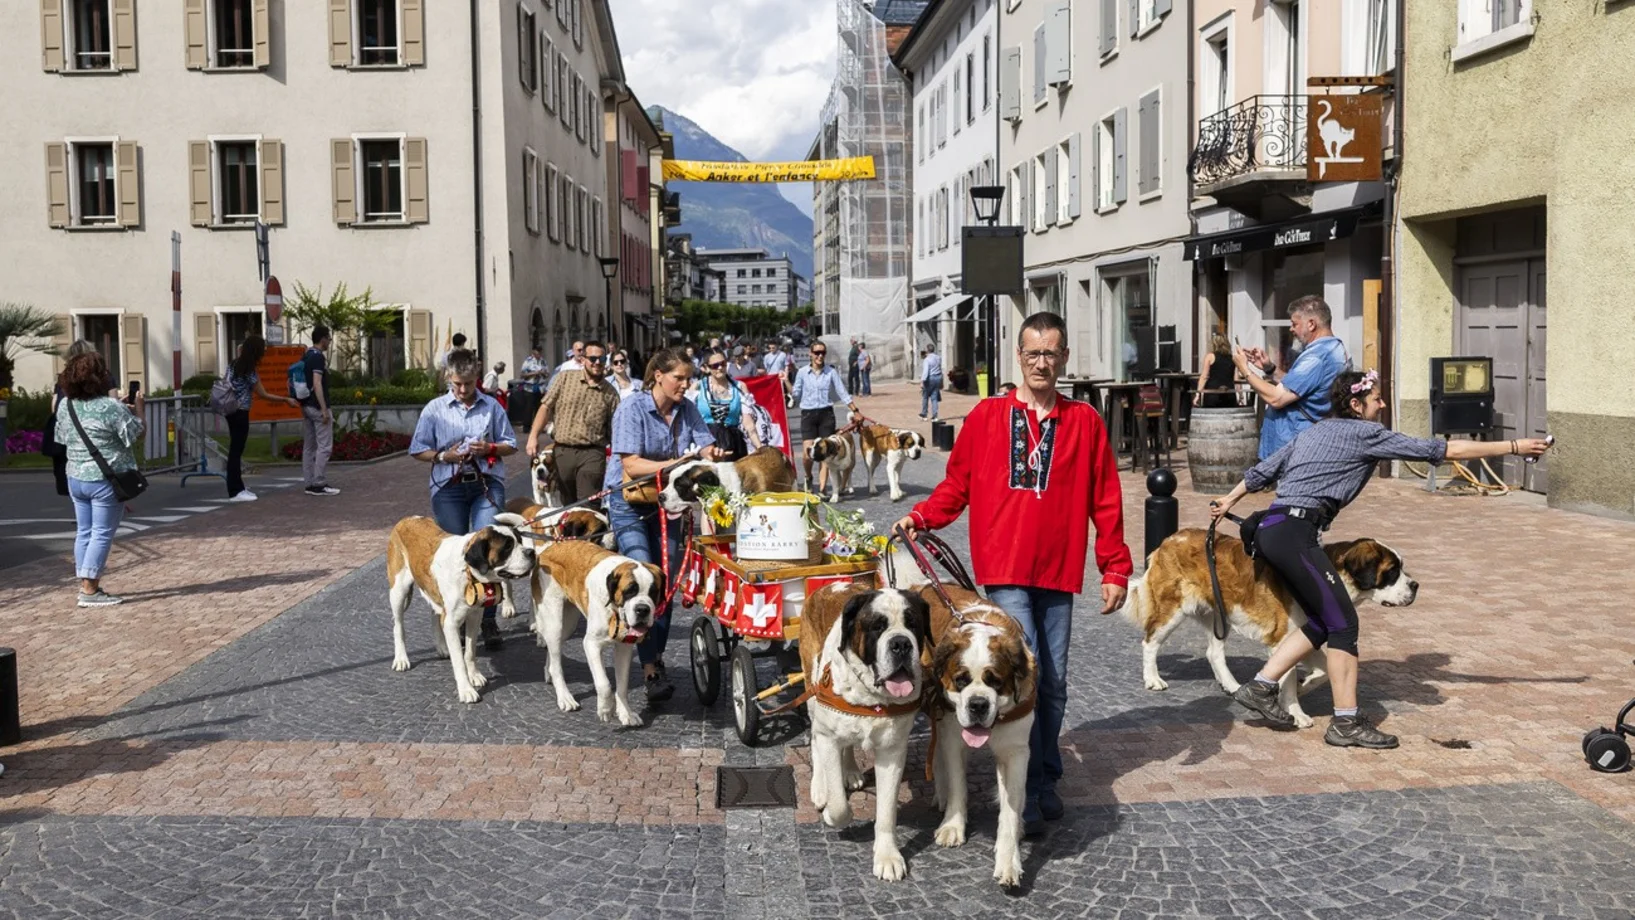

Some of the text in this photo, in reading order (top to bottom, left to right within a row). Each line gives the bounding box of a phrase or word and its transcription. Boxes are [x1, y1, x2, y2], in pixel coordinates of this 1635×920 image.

[706, 171, 819, 181] Anker et l'enfance
